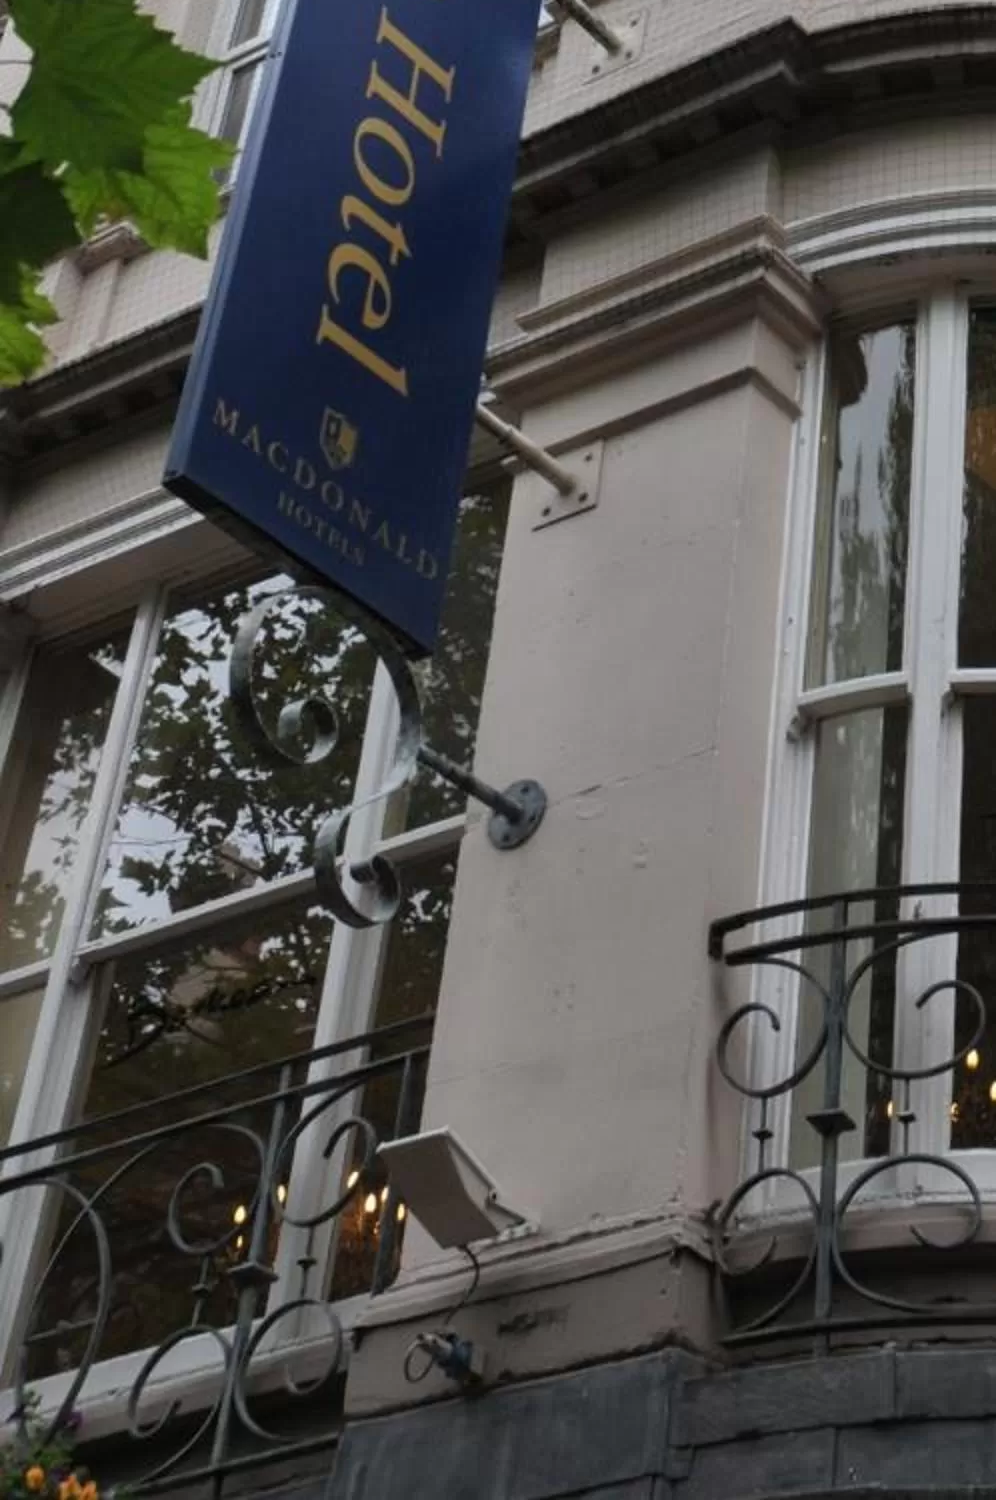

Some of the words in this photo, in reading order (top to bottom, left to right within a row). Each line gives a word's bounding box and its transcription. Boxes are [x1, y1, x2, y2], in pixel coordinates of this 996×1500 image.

[316, 6, 457, 397] Hotel
[212, 397, 438, 579] MACDONALD
[277, 490, 366, 567] HOTELS
